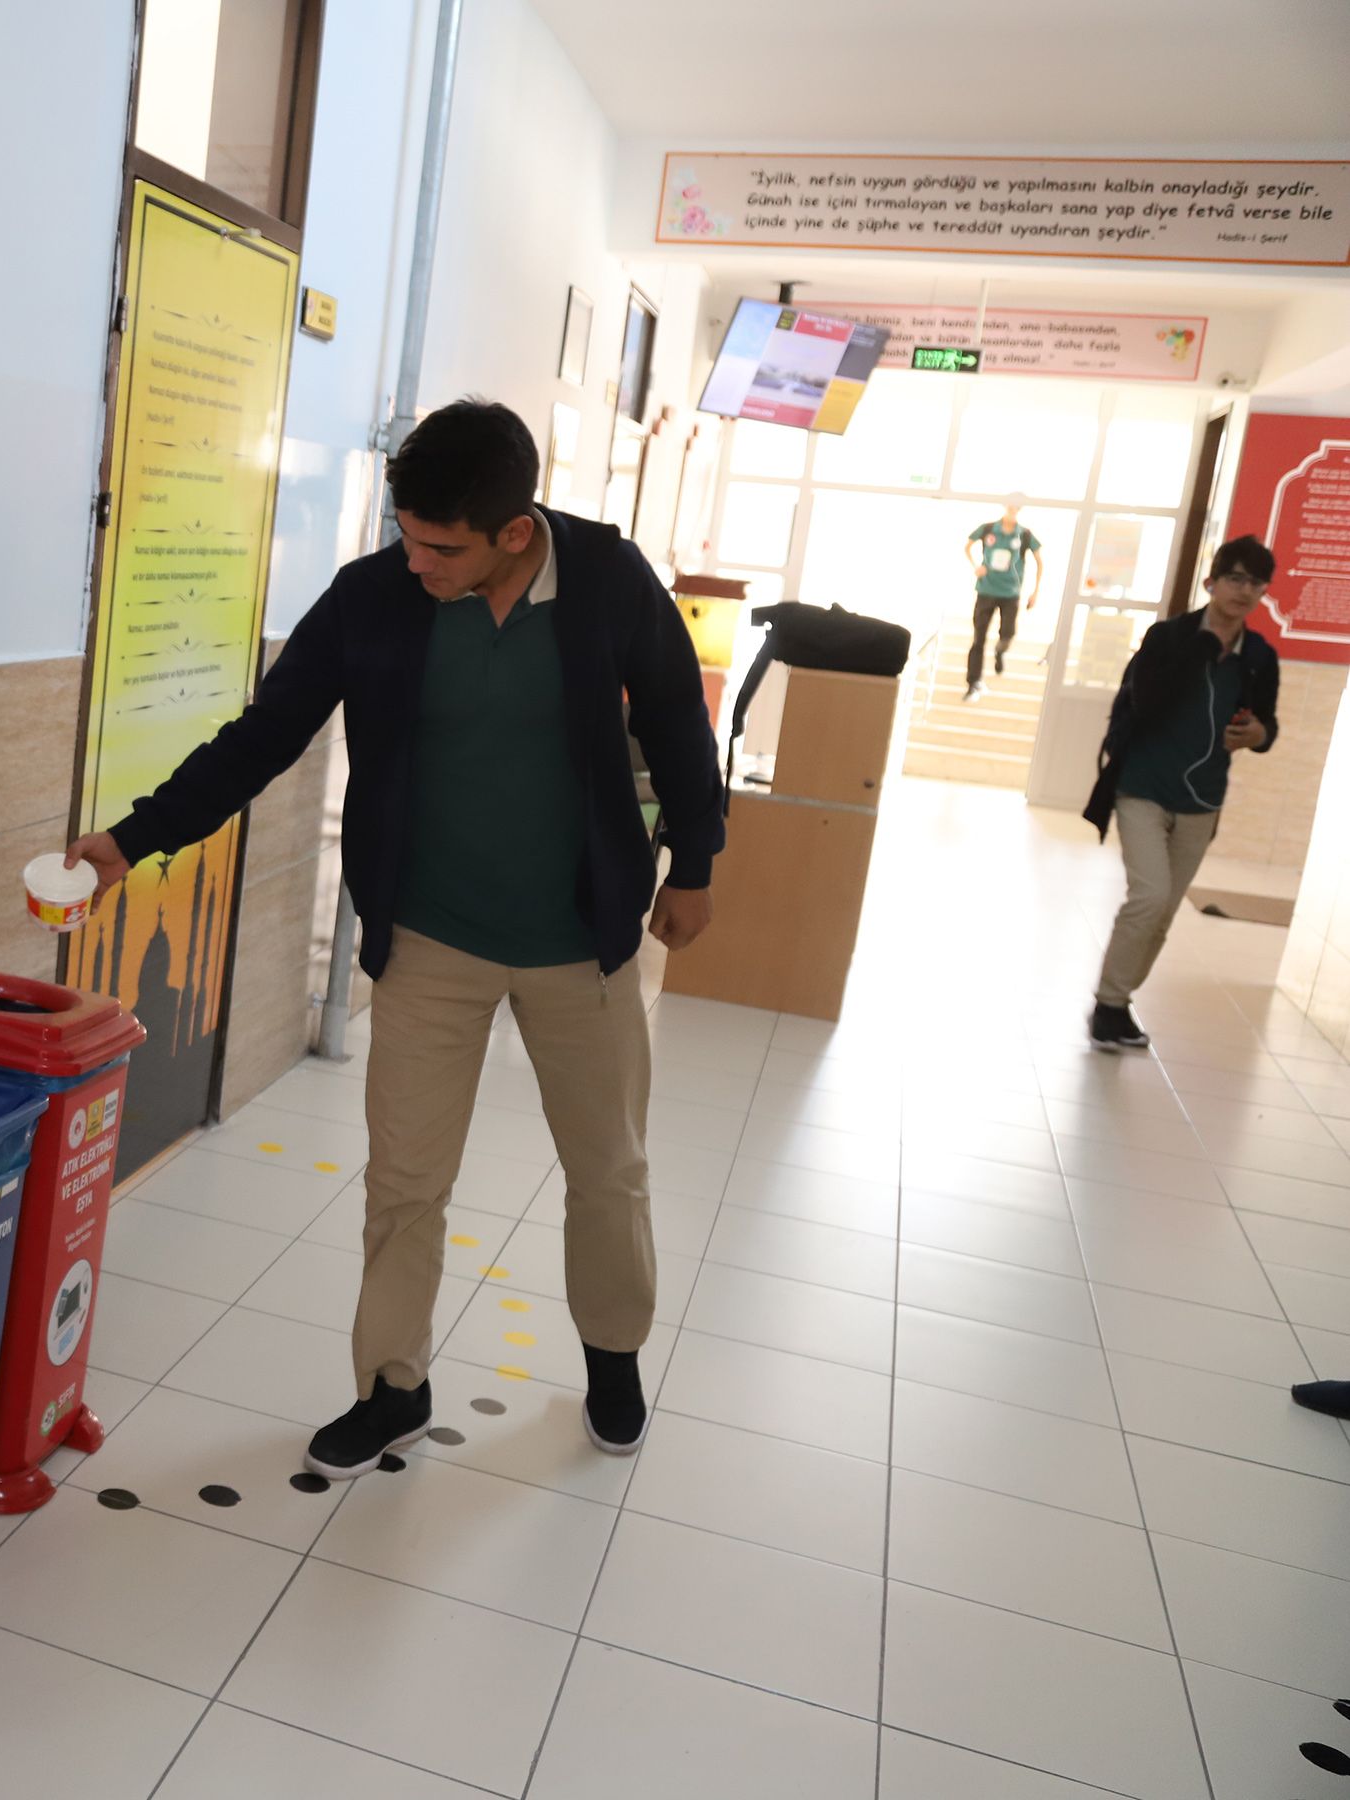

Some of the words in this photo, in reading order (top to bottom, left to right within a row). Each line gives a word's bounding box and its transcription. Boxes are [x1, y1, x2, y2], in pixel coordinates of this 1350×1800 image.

[809, 172, 856, 187] nefsin
[863, 176, 907, 192] uygun
[913, 174, 977, 193] gördüğü
[983, 180, 1000, 190] ve
[1007, 177, 1097, 195] yapılmasını
[1104, 179, 1155, 194] kalbin
[1161, 181, 1249, 199] onayladığı
[1256, 182, 1320, 200] şeydir.
[747, 192, 792, 207] Günah
[799, 194, 820, 207] ise
[827, 195, 858, 209] içini
[864, 196, 947, 214] tırmalayan
[954, 201, 971, 211] ve
[978, 199, 1053, 215] başkaları
[1060, 204, 1098, 215] sana
[1105, 204, 1135, 219] yap
[1142, 202, 1178, 221] diye
[1186, 203, 1235, 218] fetvâ
[1242, 207, 1292, 220] verse
[1299, 205, 1334, 220] bile
[744, 214, 788, 229] içinde
[794, 215, 824, 232] yine
[831, 217, 850, 230] de
[857, 218, 900, 234] şüphe
[908, 222, 925, 232] ve
[933, 220, 1003, 236] tereddüt
[1010, 222, 1090, 240] uyandıran
[1054, 339, 1083, 350] daha
[62, 1154, 79, 1179] ATIK
[62, 1182, 72, 1200] VE
[76, 1190, 93, 1214] EŞYA
